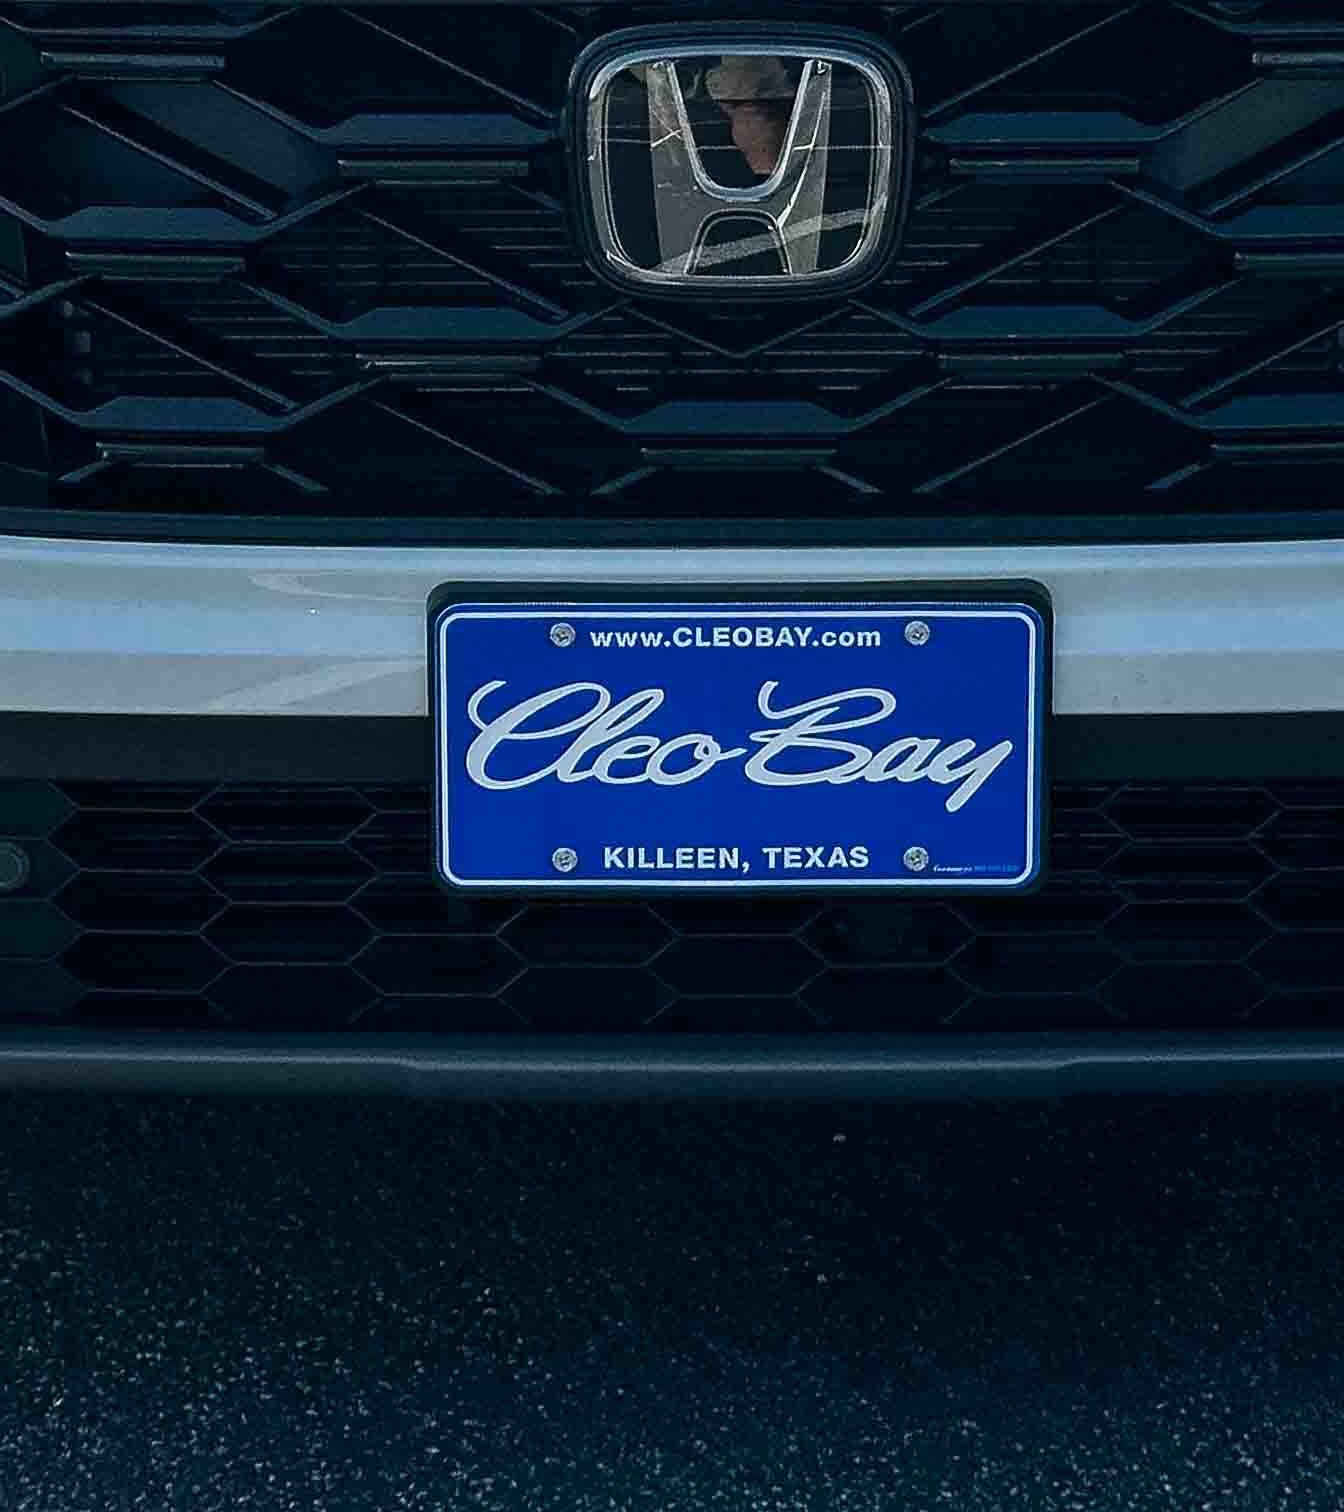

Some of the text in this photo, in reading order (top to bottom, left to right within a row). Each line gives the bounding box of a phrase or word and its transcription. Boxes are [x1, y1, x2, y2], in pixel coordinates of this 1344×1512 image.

[589, 626, 882, 648] www.CLEOBAY.com
[465, 680, 1014, 814] Cleo Bay
[603, 845, 870, 874] KILLEEN, TEXAS
